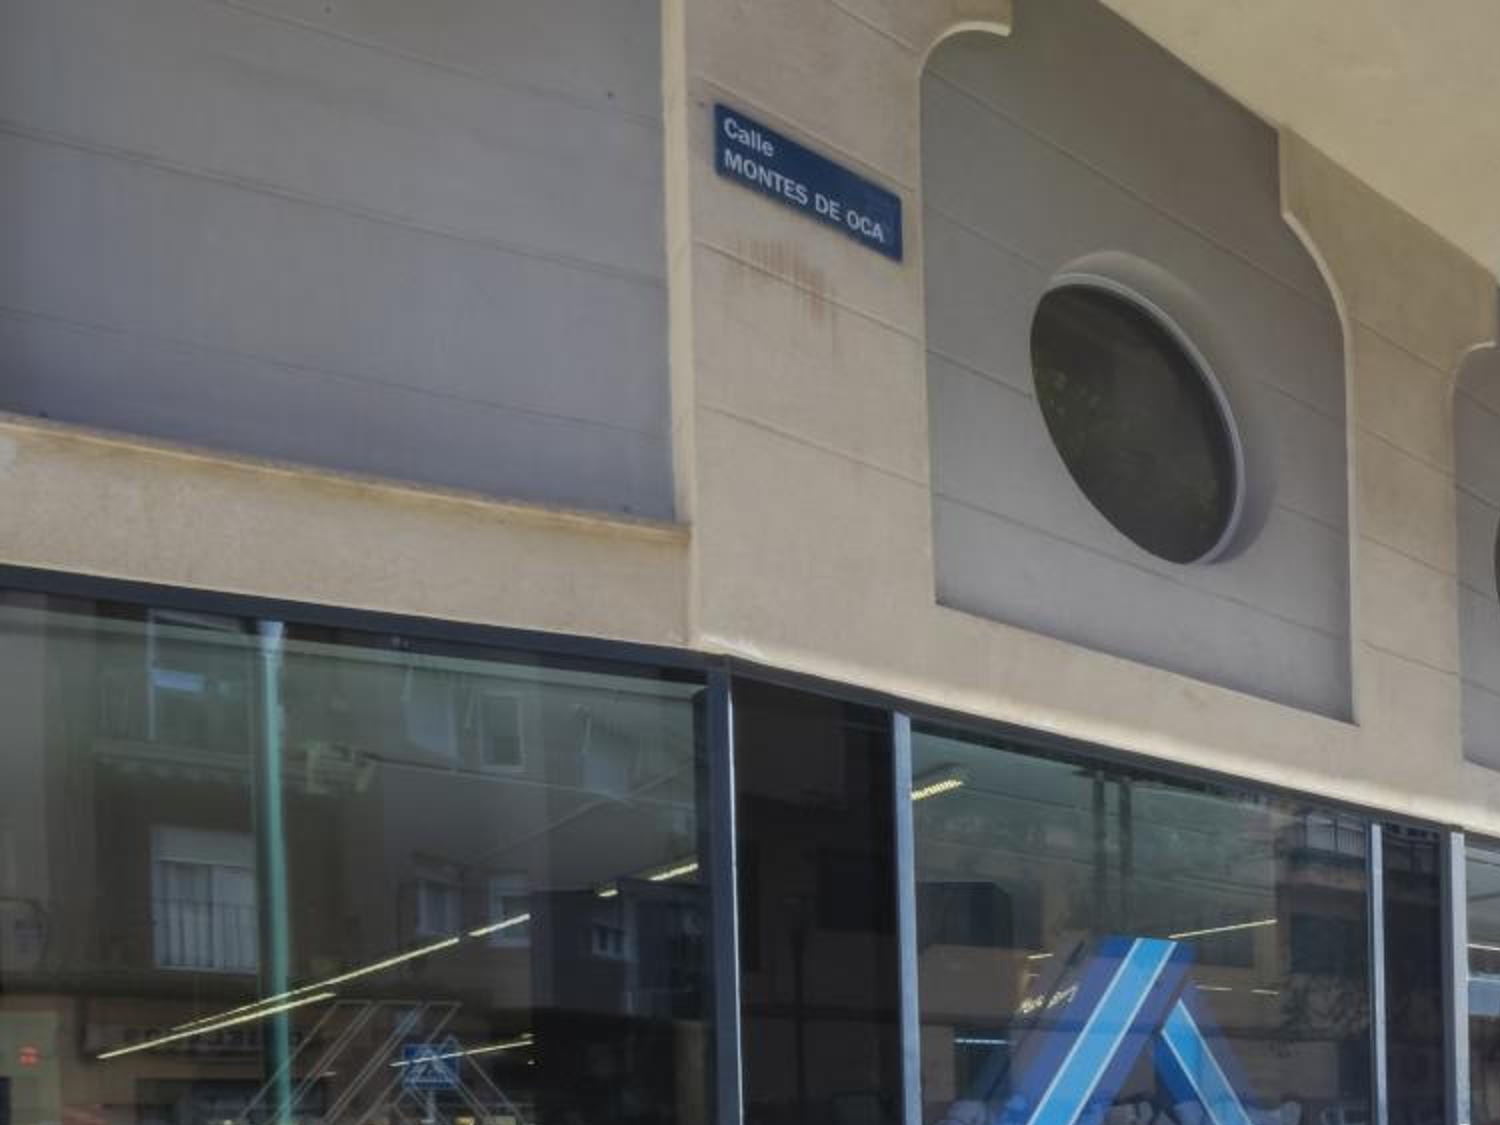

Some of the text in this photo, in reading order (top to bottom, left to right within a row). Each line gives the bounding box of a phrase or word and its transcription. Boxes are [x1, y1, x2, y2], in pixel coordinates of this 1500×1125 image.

[723, 117, 774, 157] Calle
[724, 147, 885, 243] MONTES DE OCA
